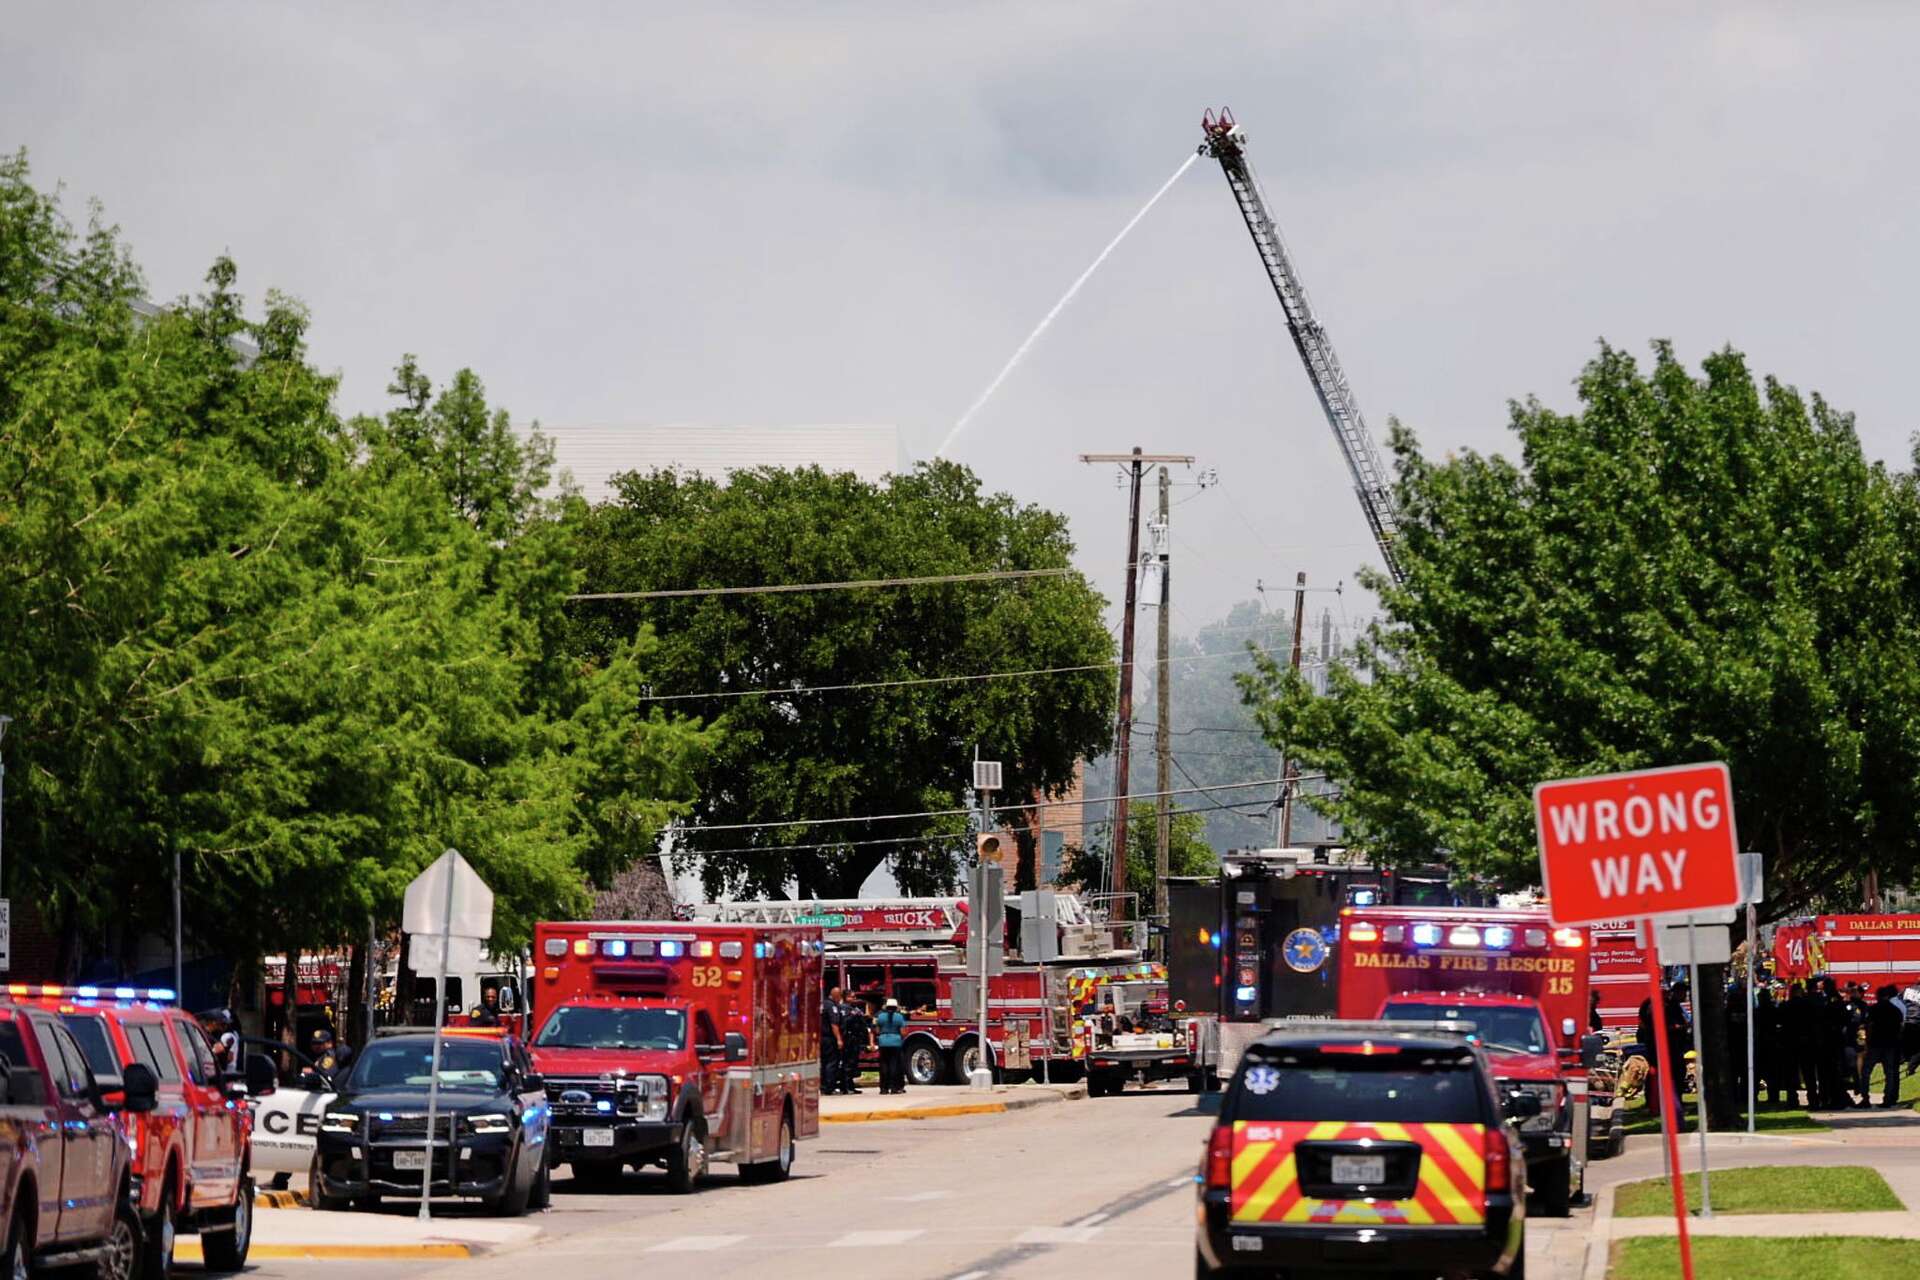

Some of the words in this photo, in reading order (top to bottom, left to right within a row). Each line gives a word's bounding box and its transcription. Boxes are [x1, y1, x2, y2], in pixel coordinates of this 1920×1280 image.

[1549, 788, 1721, 846] WRONG
[1591, 848, 1687, 899] WAY
[884, 911, 936, 926] TRUCK
[1591, 920, 1628, 930] SCUE
[1849, 920, 1893, 930] DALLAS
[1354, 952, 1431, 970] DALLAS
[1440, 956, 1488, 972] FIRE
[1496, 957, 1575, 974] RESCUE
[1785, 939, 1805, 966] 14
[692, 966, 722, 988] 52
[1548, 976, 1574, 995] 15
